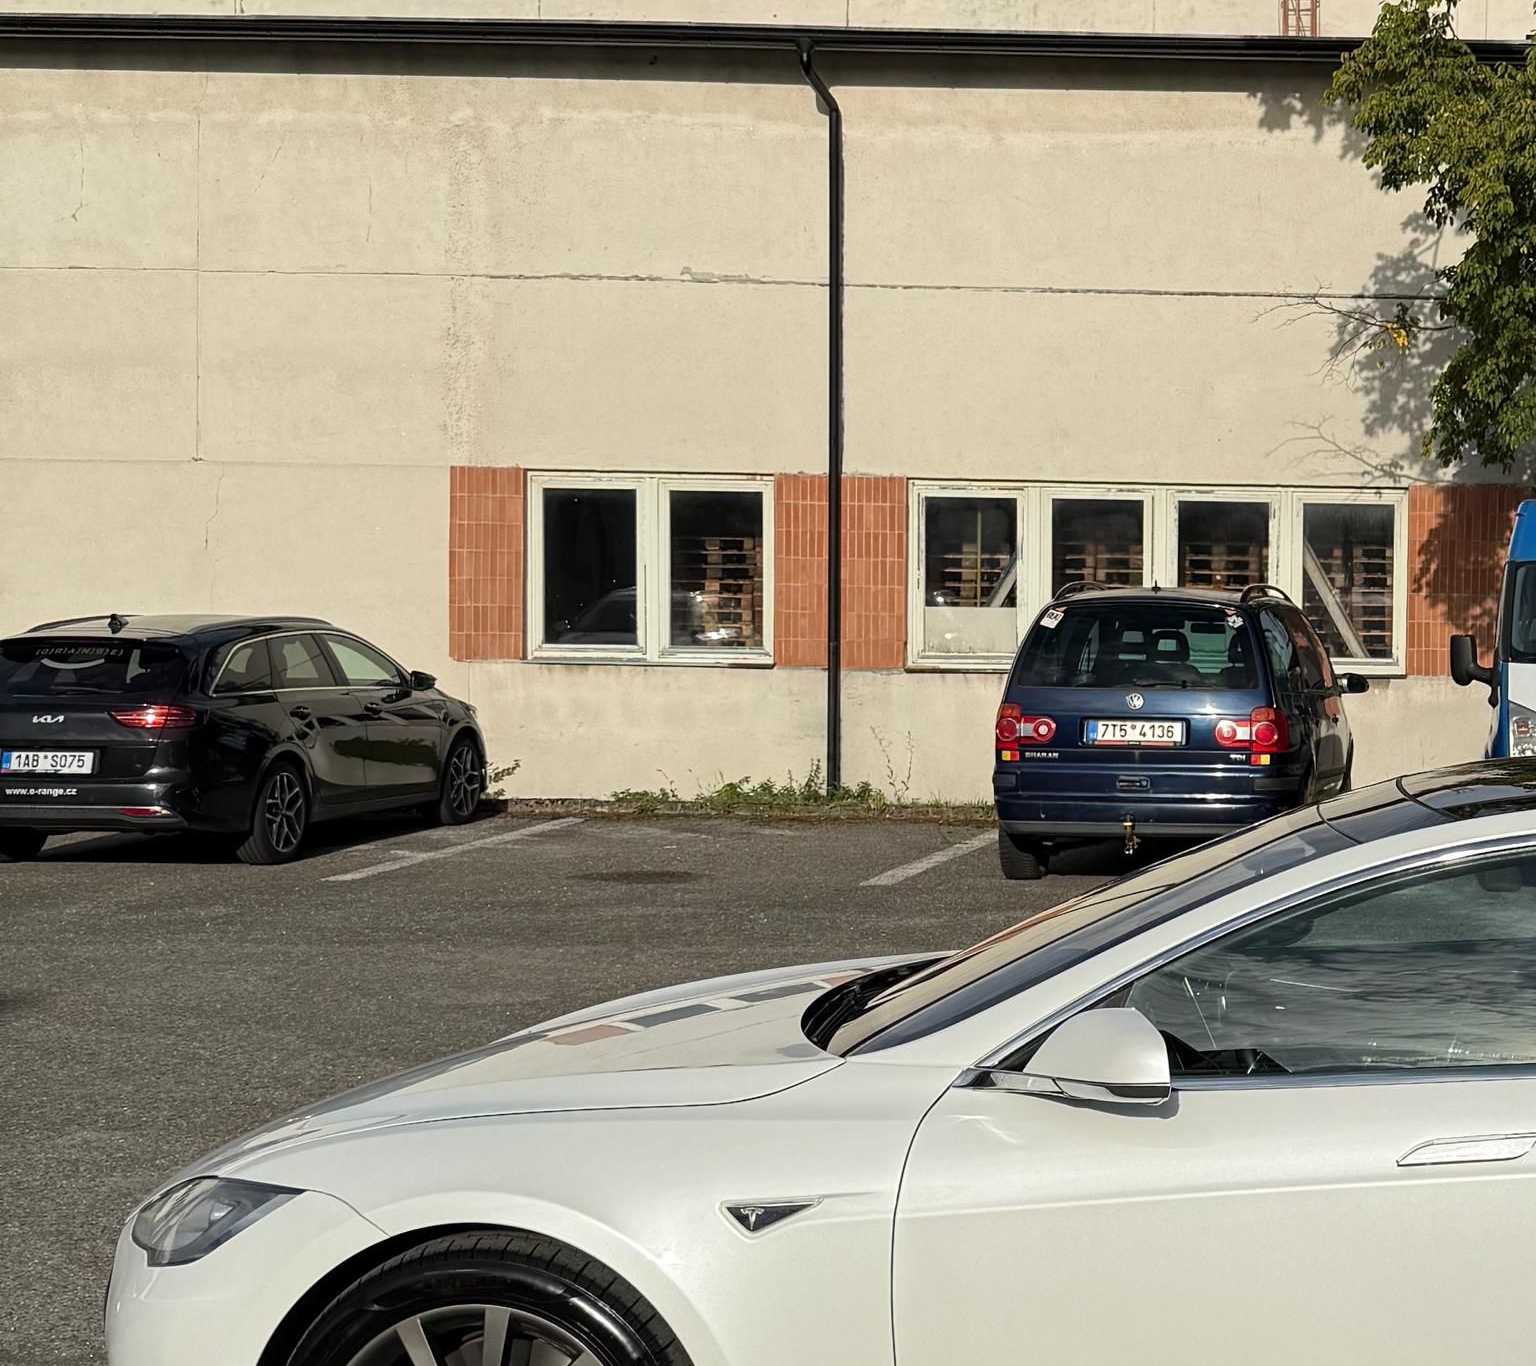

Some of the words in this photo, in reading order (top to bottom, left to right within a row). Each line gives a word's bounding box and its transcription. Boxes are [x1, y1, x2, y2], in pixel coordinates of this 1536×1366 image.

[32, 715, 65, 724] KIA
[1101, 724, 1128, 738] 7T5
[1139, 724, 1174, 739] 4136
[15, 754, 40, 768] 1AB
[5, 787, 78, 797] www.o-range.cz
